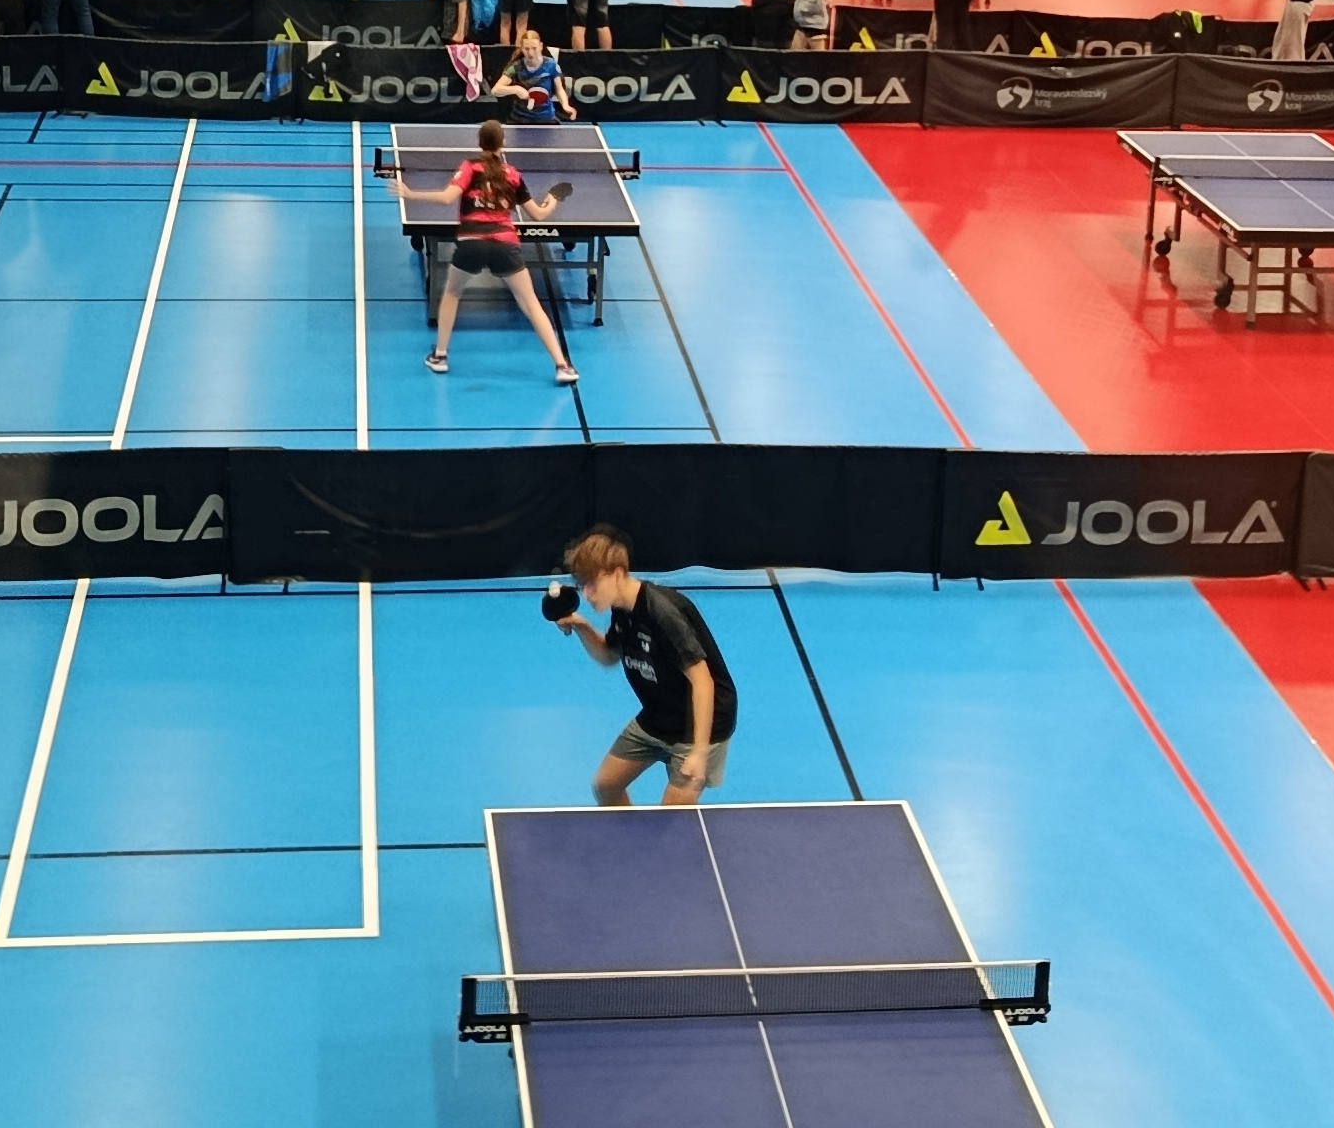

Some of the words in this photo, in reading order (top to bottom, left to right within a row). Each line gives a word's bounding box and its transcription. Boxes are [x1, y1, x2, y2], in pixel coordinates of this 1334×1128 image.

[764, 76, 911, 105] JOOLA
[1033, 98, 1053, 110] kraj
[1284, 101, 1303, 113] kraj
[522, 228, 560, 237] JOOLA
[1040, 499, 1286, 545] JOOLA
[1013, 1007, 1046, 1016] JOOLA
[473, 1025, 508, 1033] JOOLA
